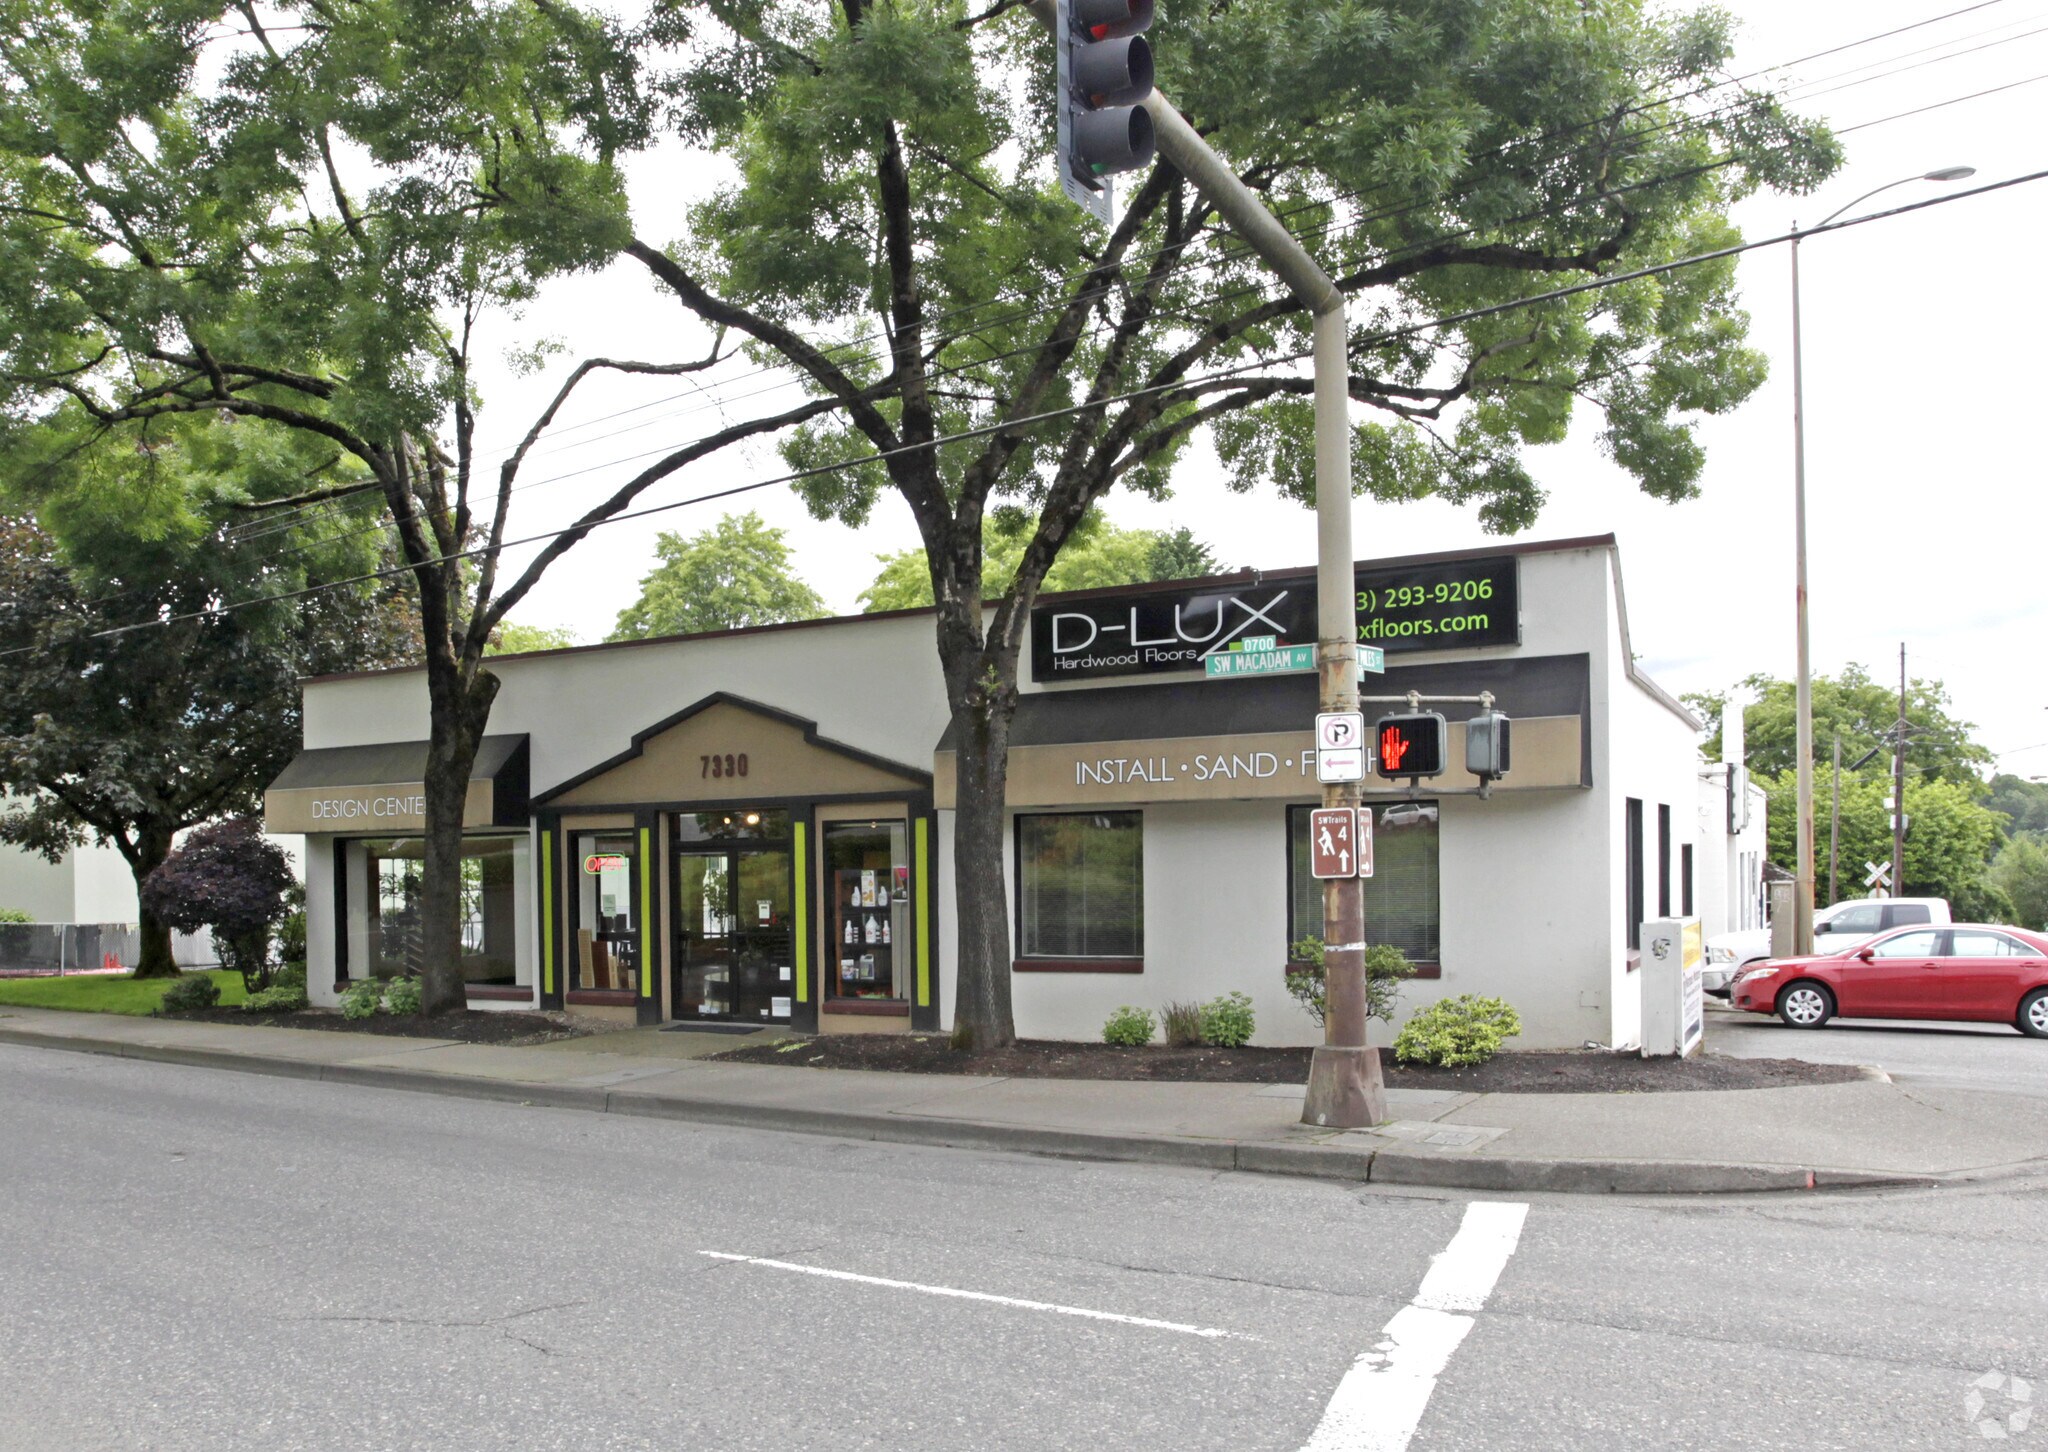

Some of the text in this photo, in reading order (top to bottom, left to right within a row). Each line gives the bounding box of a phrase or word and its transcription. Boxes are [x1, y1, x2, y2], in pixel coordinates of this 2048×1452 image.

[1384, 578, 1493, 609] 293-9206
[1052, 590, 1289, 662] D-LUX
[1355, 613, 1489, 640] xfloors.com
[1243, 637, 1274, 651] 0700
[1054, 648, 1197, 670] Hardwood Floors
[1214, 651, 1307, 673] SW MACADAM AV
[700, 753, 748, 779] 7330
[1076, 757, 1175, 785] INSTALL
[1193, 752, 1278, 781] SAND
[312, 796, 427, 819] DESIGN CENTE
[1338, 825, 1347, 841] 4
